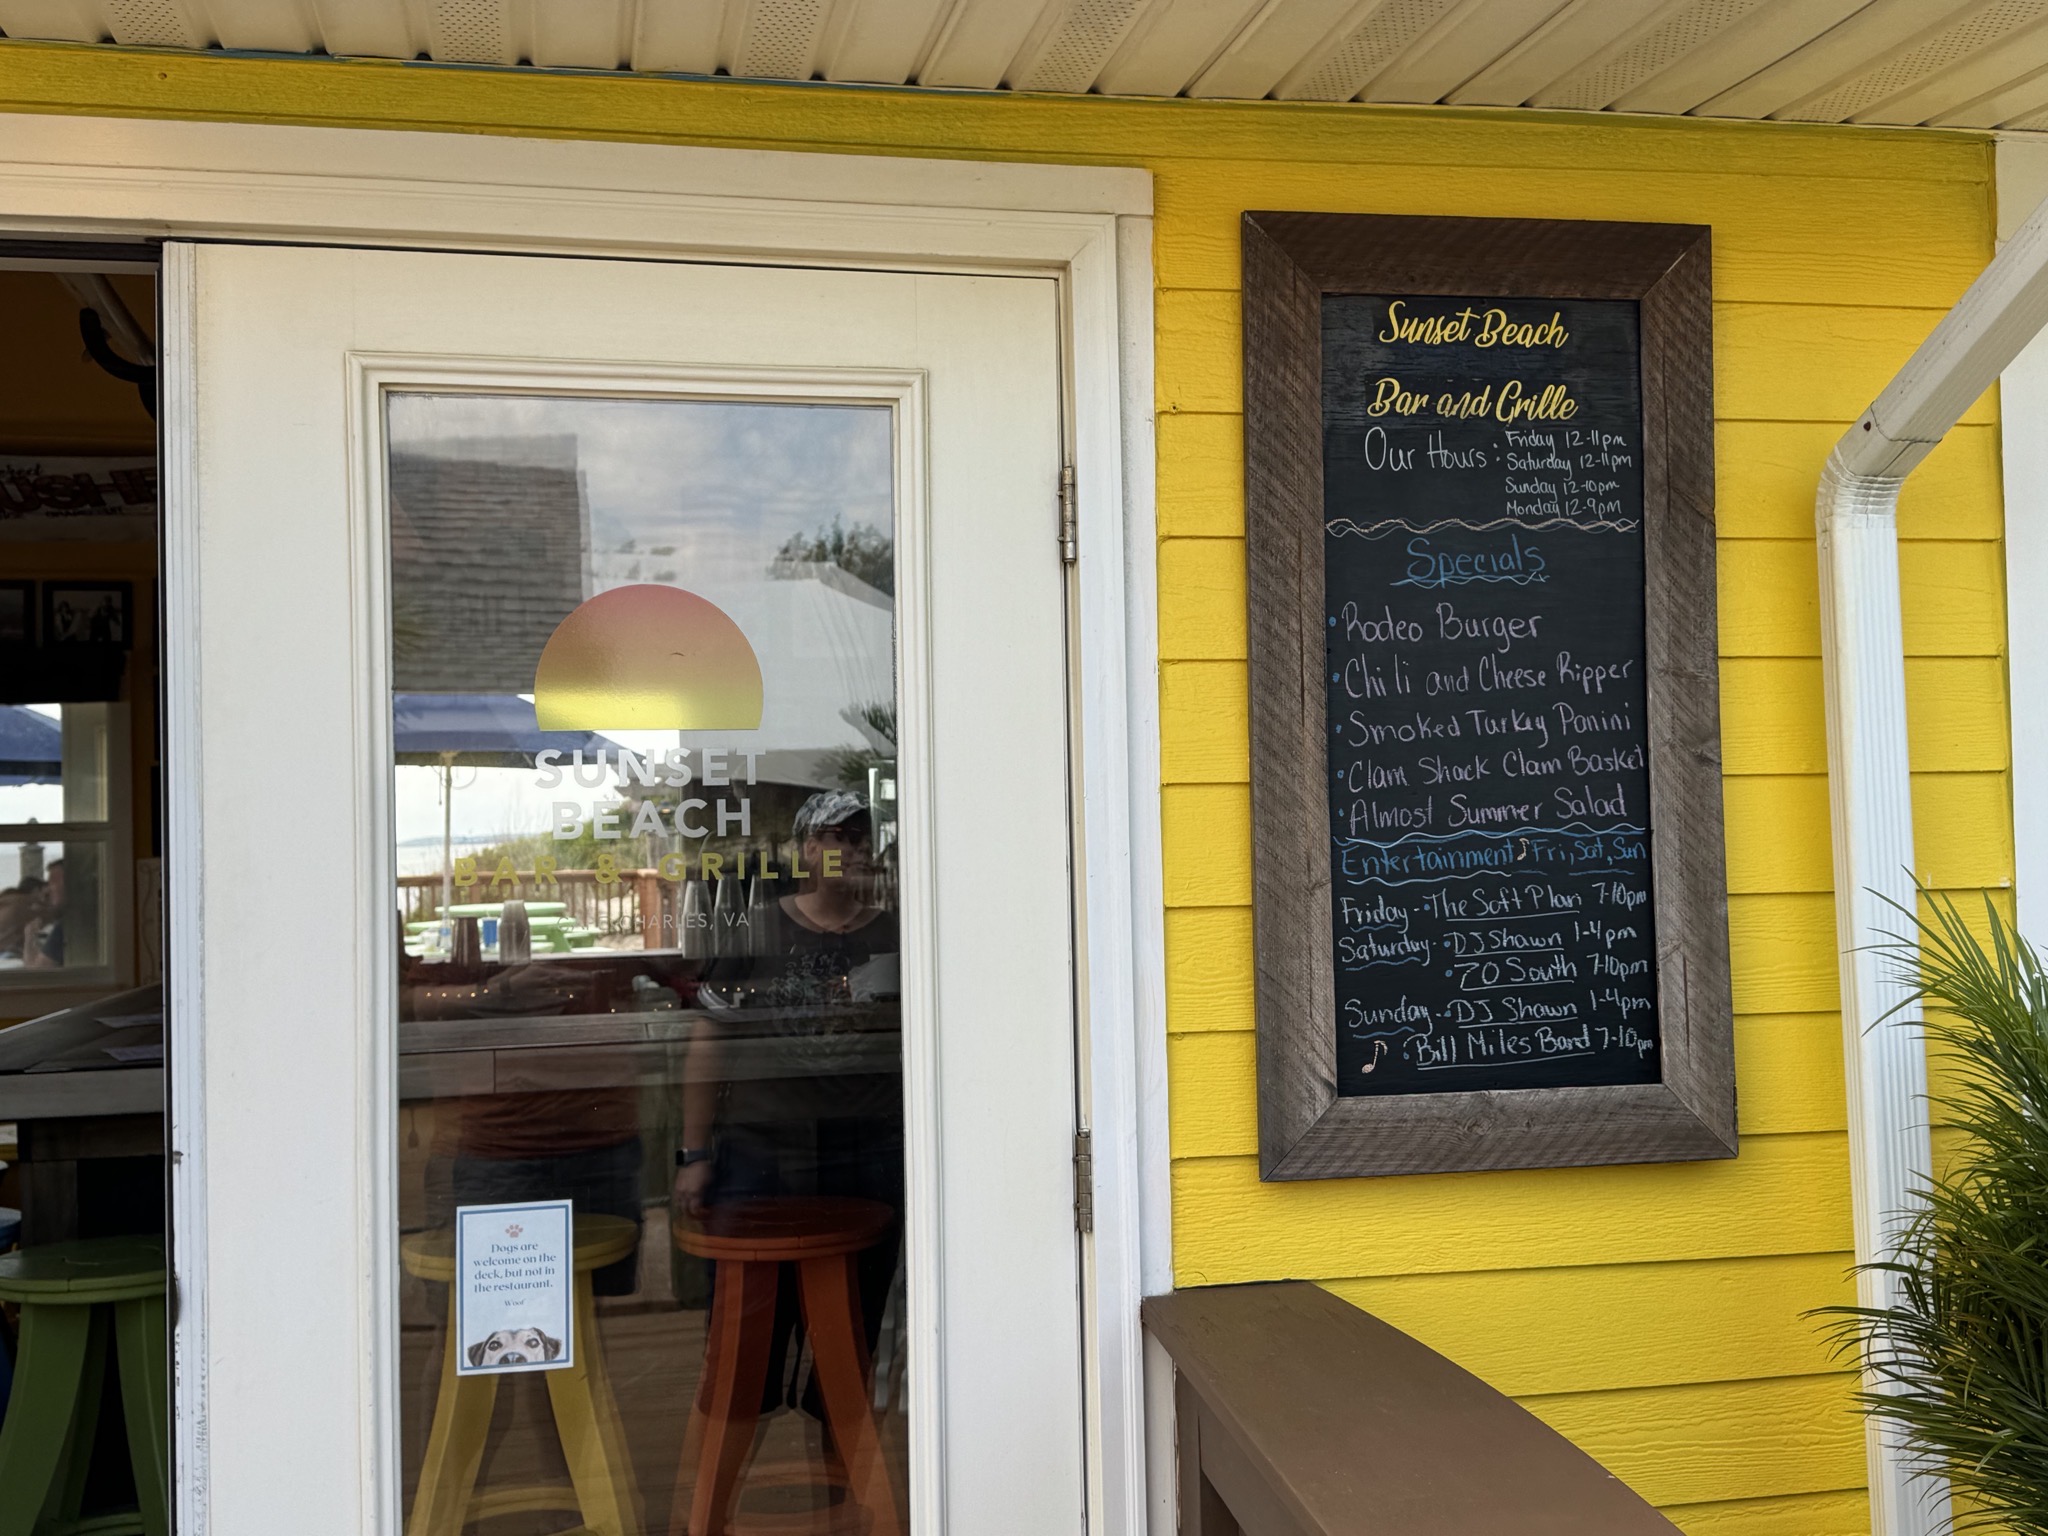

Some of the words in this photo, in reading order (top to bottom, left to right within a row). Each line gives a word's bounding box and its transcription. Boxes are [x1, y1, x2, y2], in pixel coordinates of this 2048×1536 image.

[1379, 301, 1480, 345] Sunset
[1475, 308, 1569, 348] Beach
[1367, 377, 1429, 417] Bar
[1437, 385, 1491, 420] and
[1495, 380, 1579, 423] Grille
[1365, 427, 1415, 471] Our
[1505, 429, 1556, 459] Friday
[1507, 452, 1573, 481] Saturday
[1505, 476, 1558, 503] Sunday
[1506, 498, 1561, 519] Monday
[1407, 534, 1546, 588] Specials
[1342, 601, 1424, 642] Rodeo
[1436, 602, 1543, 653] Burger
[1426, 665, 1470, 696] and
[1478, 653, 1546, 692] Cheese
[1556, 651, 1635, 694] Ripper
[1349, 710, 1460, 747] Smoked
[1466, 709, 1549, 749] Turkey
[1553, 702, 1631, 735] Panini
[534, 747, 767, 789] SUNSET
[1349, 759, 1406, 793] Clam
[1419, 755, 1491, 785] Shack
[1503, 748, 1561, 777] Clam
[1567, 744, 1645, 775] Basket
[552, 797, 752, 841] BEACH
[1350, 796, 1434, 836] Almost
[1448, 794, 1543, 827] Summer
[1554, 783, 1627, 818] Salad
[454, 855, 559, 887] BAR
[594, 853, 623, 884] &
[658, 849, 844, 882] GRILLE
[1341, 838, 1514, 876] Entertainment
[723, 912, 750, 928] VA
[1340, 895, 1409, 934] Friday
[1422, 888, 1468, 918] The
[1472, 886, 1522, 916] Soft
[1591, 881, 1647, 912] 7-10pm
[1338, 933, 1431, 966] Saturday
[1444, 932, 1486, 955] DJ
[1488, 928, 1562, 949] Shawn
[1506, 954, 1578, 982] South
[1586, 952, 1649, 983] 7-10pm
[1344, 995, 1433, 1036] Sunday
[1448, 1000, 1494, 1023] DJ
[1501, 997, 1578, 1019] Shawn
[1405, 1034, 1457, 1066] Bill
[1467, 1028, 1532, 1060] Miles
[1535, 1023, 1591, 1055] Band
[473, 1257, 520, 1267] welcome
[522, 1256, 537, 1264] on
[539, 1253, 556, 1262] the
[491, 1244, 518, 1254] Dogs
[520, 1243, 538, 1251] are
[474, 1269, 502, 1280] deck,
[505, 1268, 522, 1278] but
[525, 1267, 542, 1277] not
[545, 1266, 555, 1275] in
[474, 1283, 491, 1293] the
[494, 1279, 553, 1291] restaurant.
